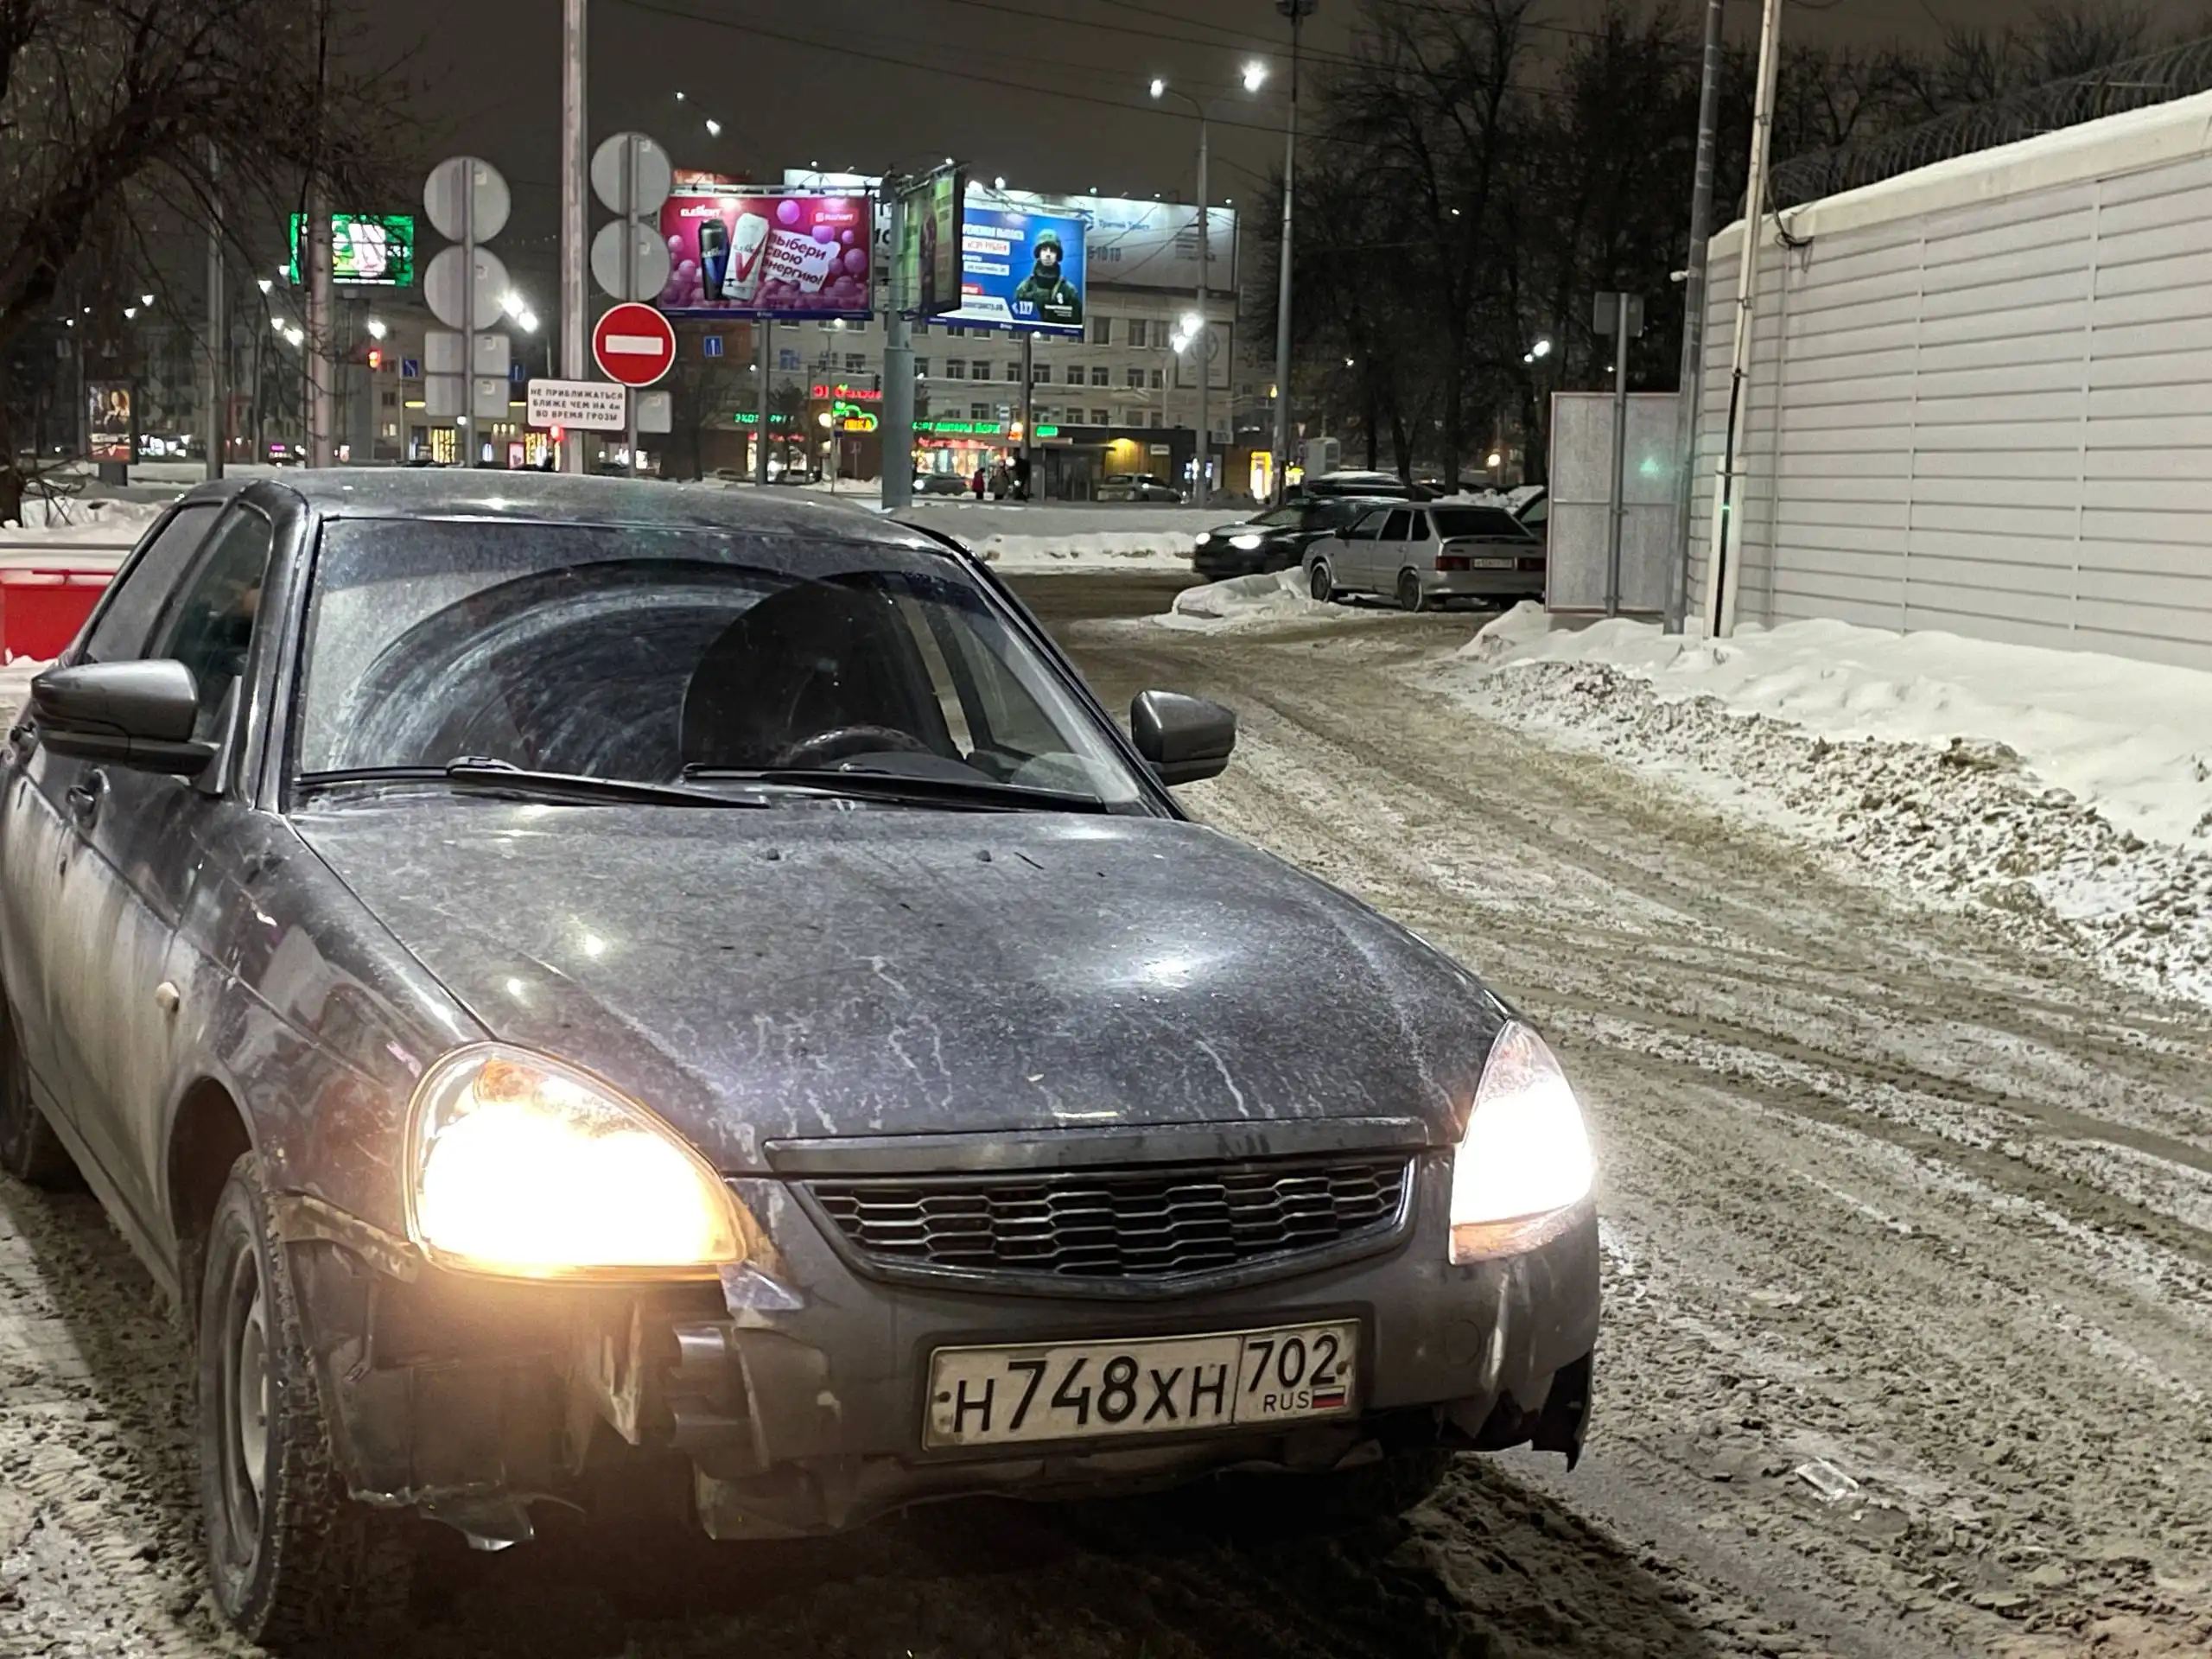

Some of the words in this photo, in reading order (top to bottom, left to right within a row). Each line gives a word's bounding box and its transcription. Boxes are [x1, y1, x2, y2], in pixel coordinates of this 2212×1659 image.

[545, 389, 623, 400] ПРИБЛИЖАТЬСЯ
[532, 399, 567, 409] БЛИЖЕ
[551, 410, 583, 419] ВРЕМЯ
[586, 412, 618, 422] ГРОЗЫ
[1248, 1333, 1341, 1393] 702
[1262, 1389, 1311, 1413] RUS
